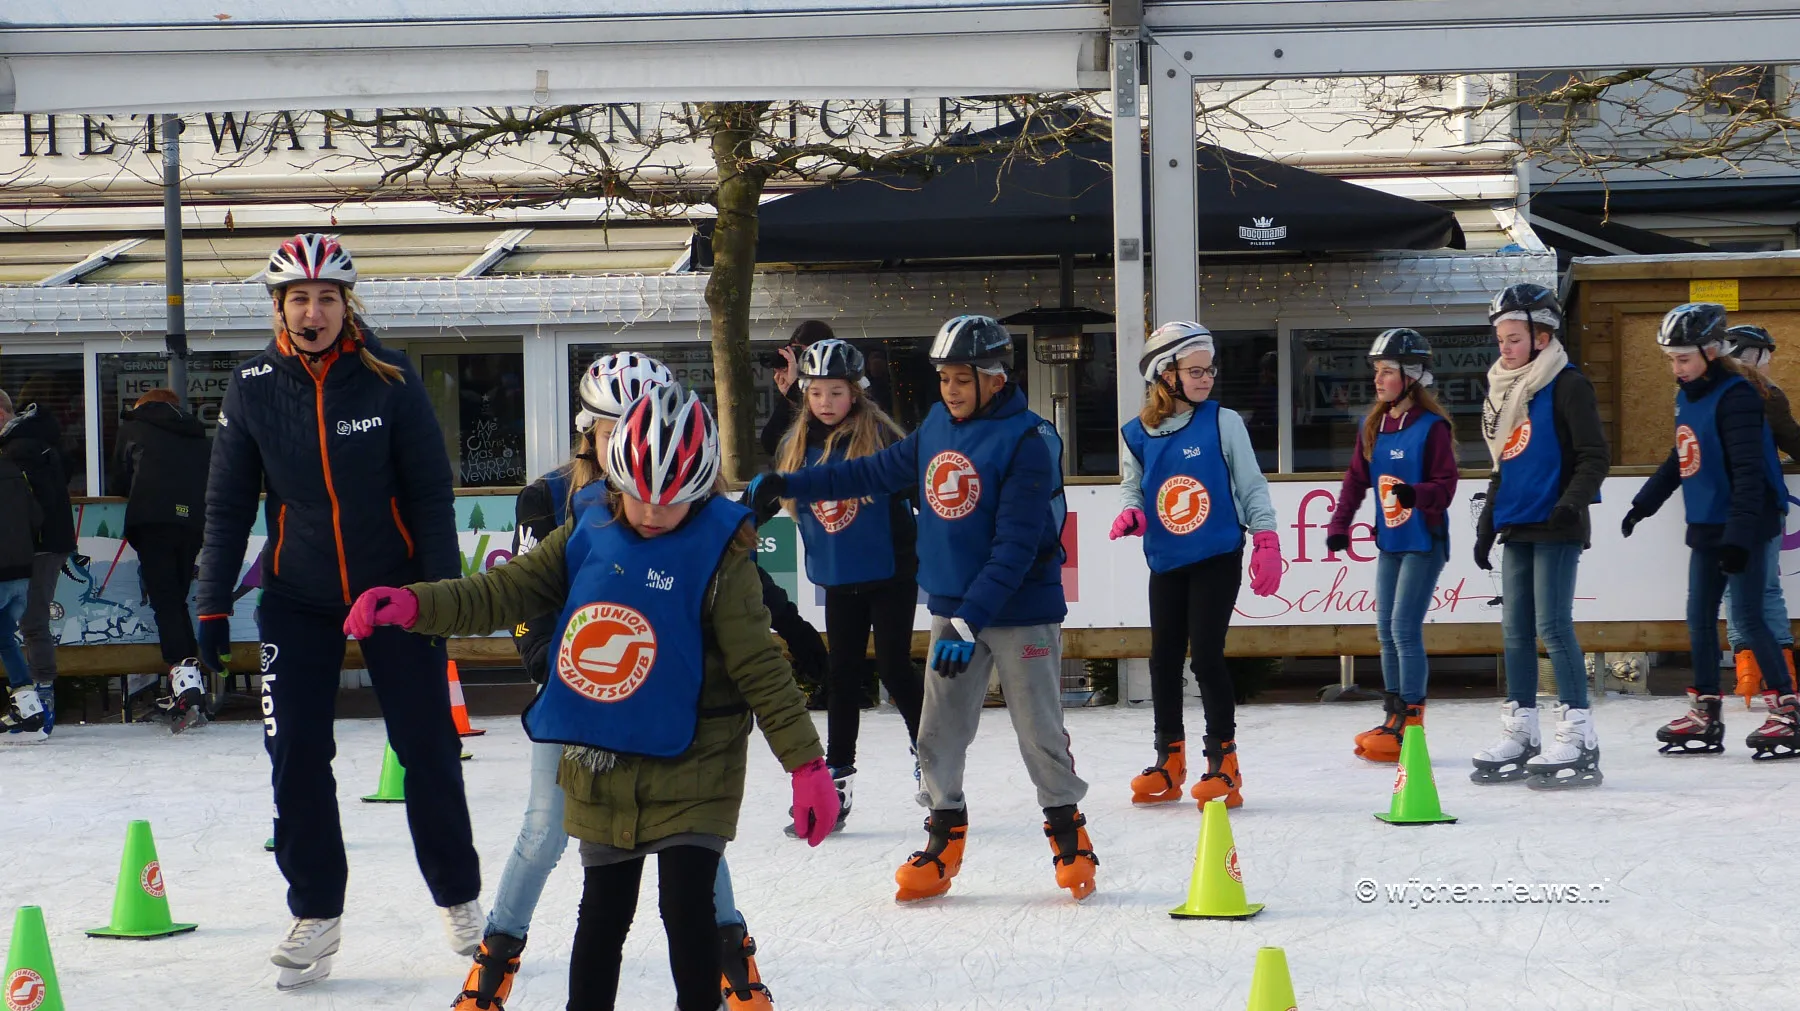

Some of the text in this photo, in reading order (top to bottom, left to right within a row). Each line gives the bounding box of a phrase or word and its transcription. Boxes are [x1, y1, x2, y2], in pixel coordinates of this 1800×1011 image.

[1449, 353, 1492, 367] VAN
[241, 363, 273, 379] FILA
[352, 416, 383, 433] kpn
[936, 453, 970, 471] JUNIOR
[1164, 477, 1197, 491] JUNIOR
[926, 483, 979, 517] SCHAATSCLUB
[1160, 497, 1208, 532] SCHAATSCLUB
[565, 607, 648, 642] KPN JUNIOR
[560, 645, 650, 698] SCHAATSCLUB
